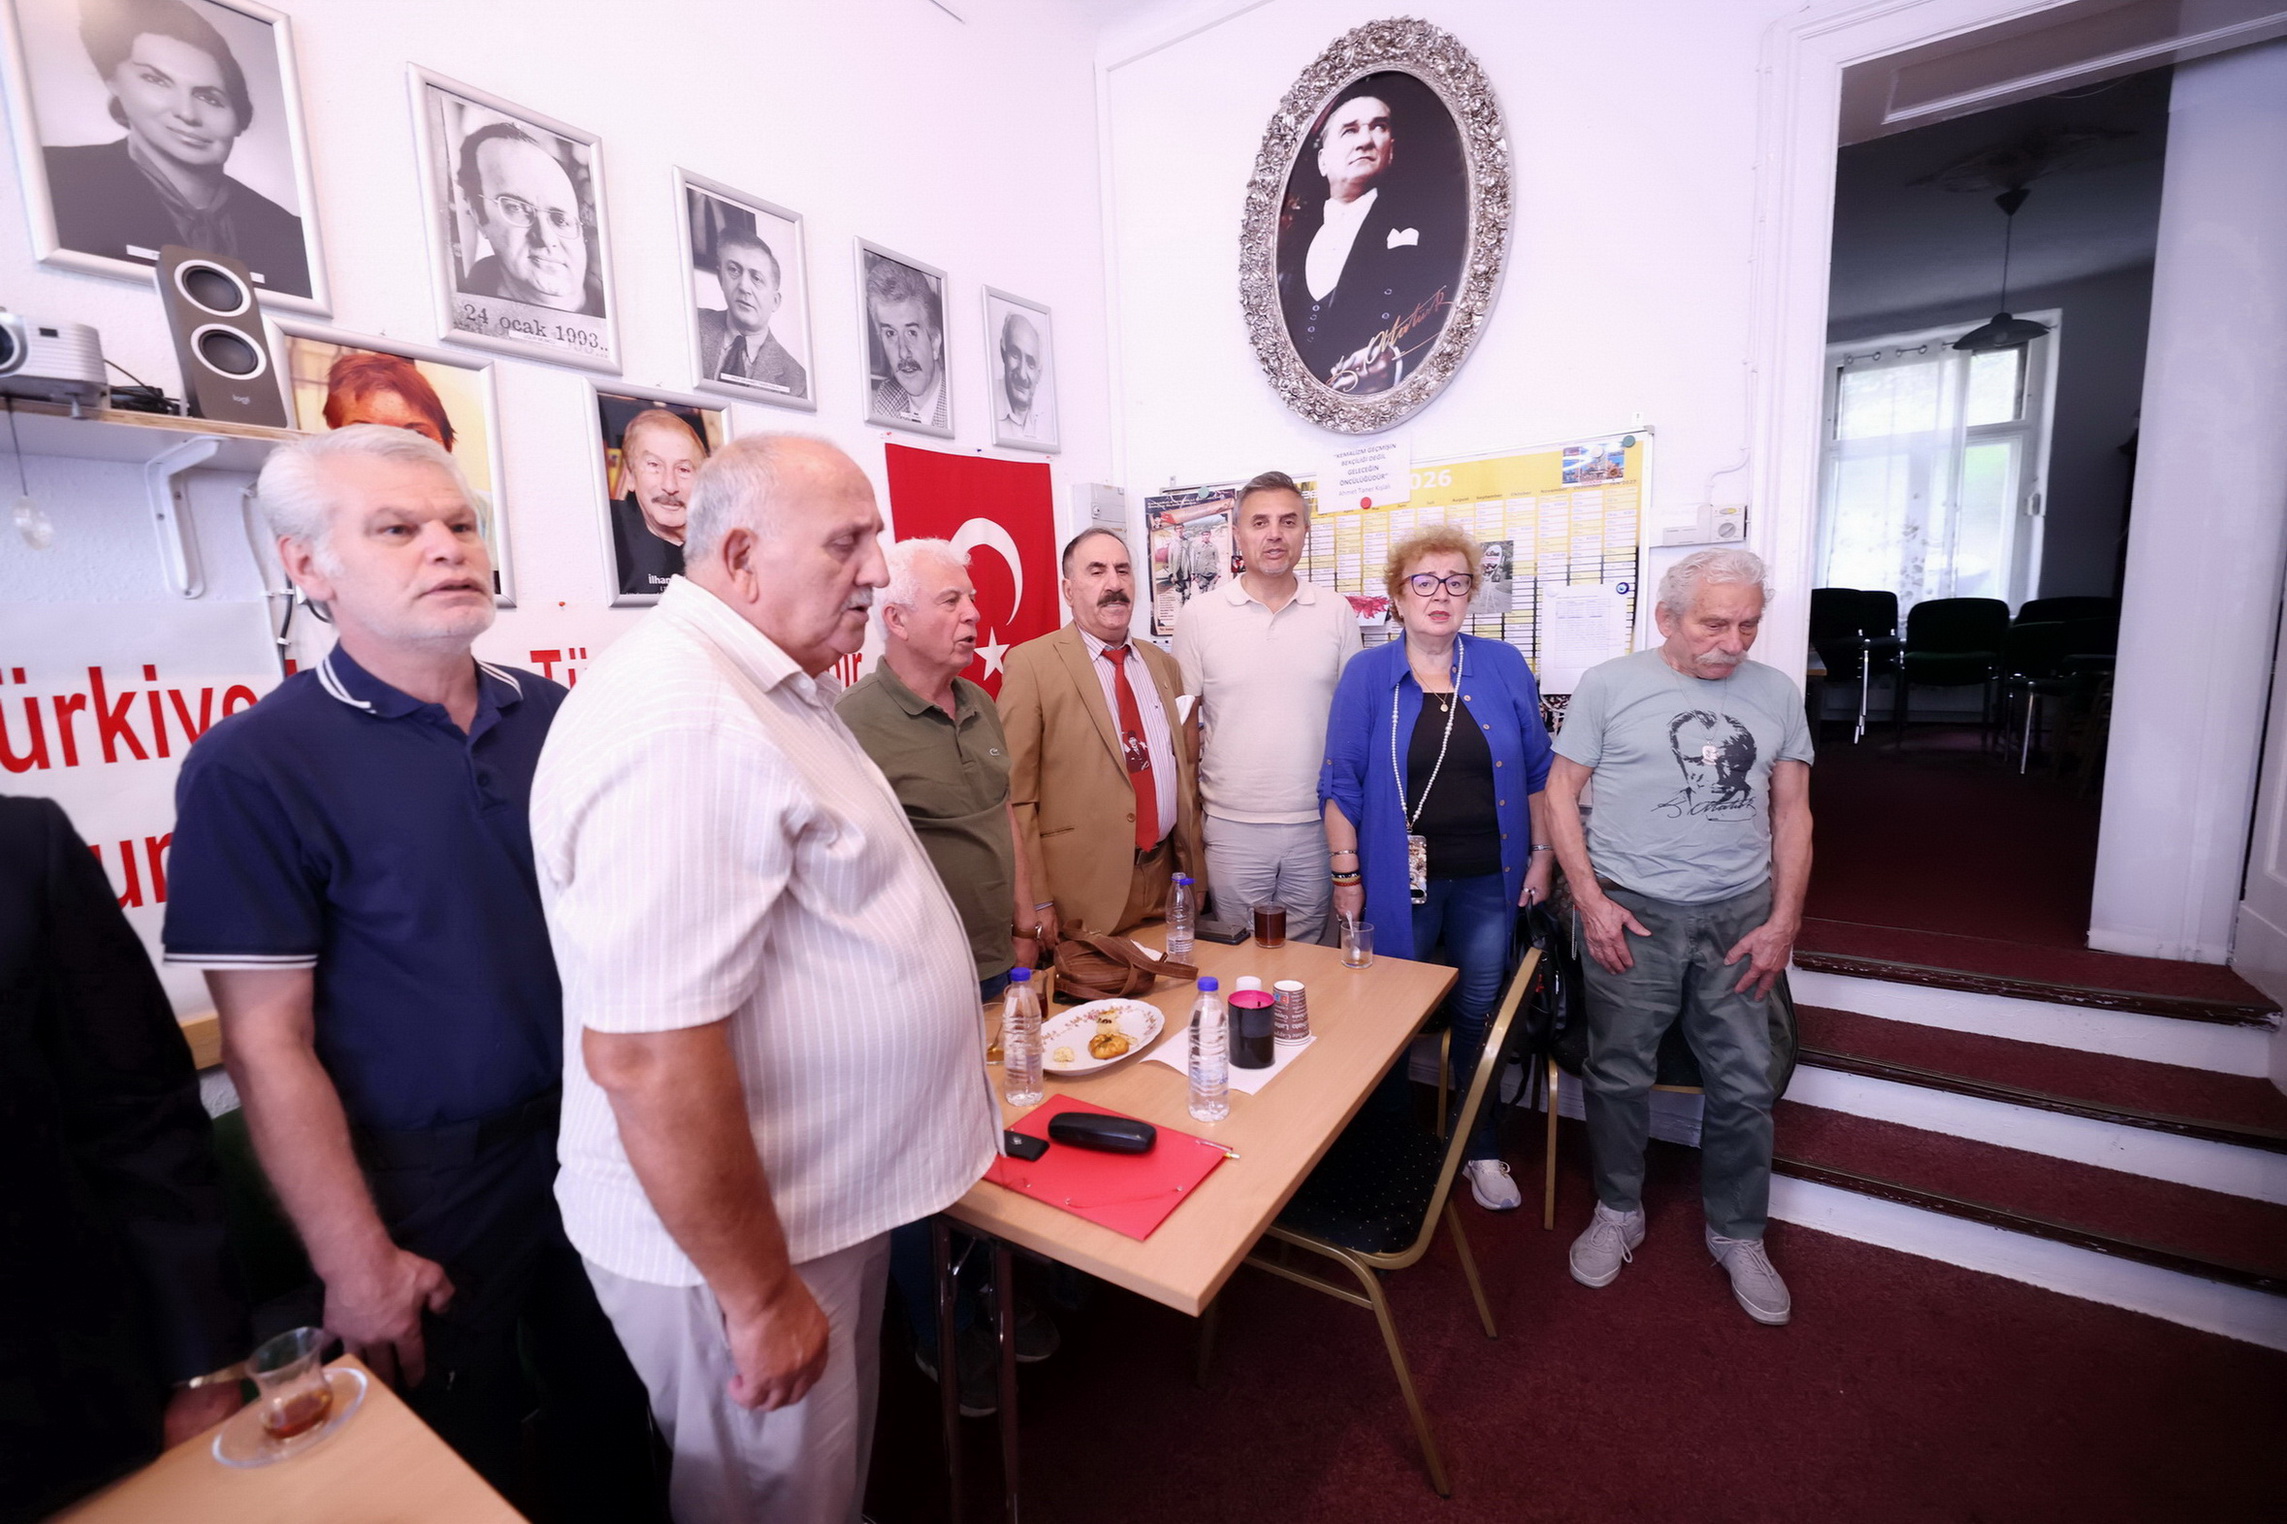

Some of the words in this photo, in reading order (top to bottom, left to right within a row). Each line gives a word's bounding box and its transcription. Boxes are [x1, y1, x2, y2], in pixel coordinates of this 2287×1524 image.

[464, 303, 489, 325] 24
[499, 316, 547, 338] ocak
[1410, 469, 1453, 491] 026
